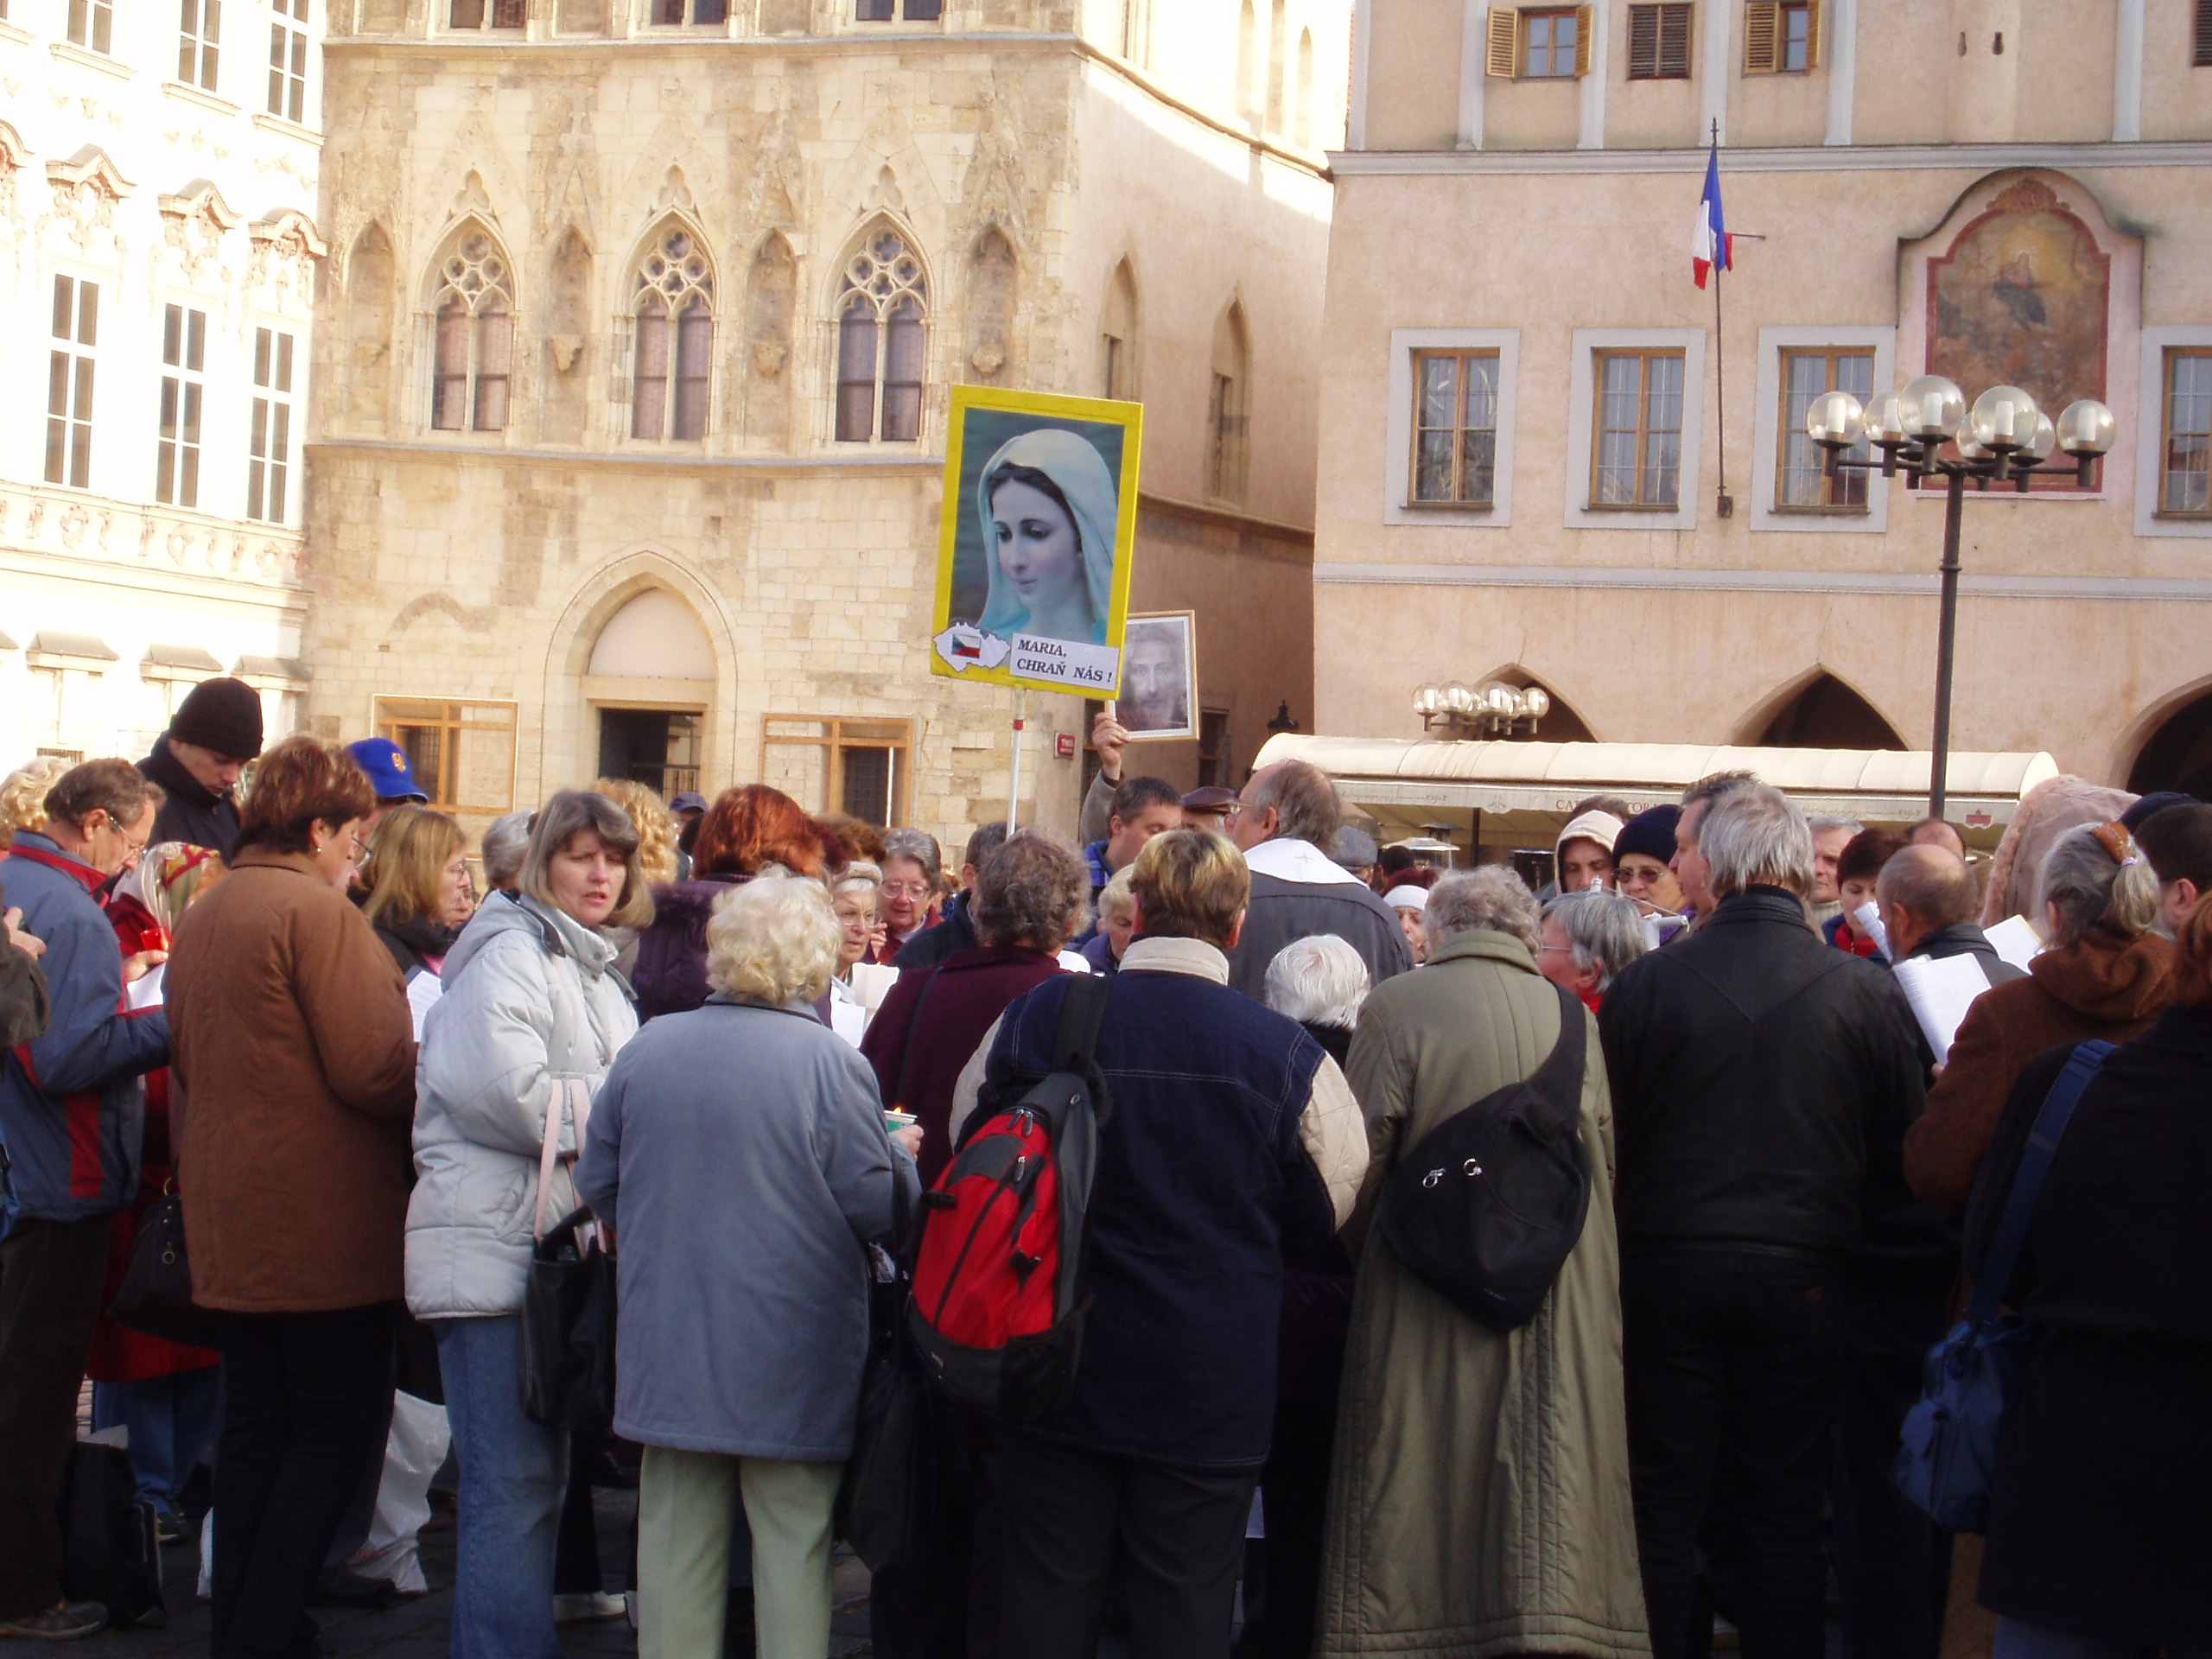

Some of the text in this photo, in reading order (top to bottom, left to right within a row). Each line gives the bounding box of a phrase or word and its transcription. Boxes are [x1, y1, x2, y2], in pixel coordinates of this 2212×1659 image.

[1018, 639, 1067, 658] MARIA,
[1017, 658, 1066, 677] CHRAŇ
[1073, 664, 1103, 682] NÁS
